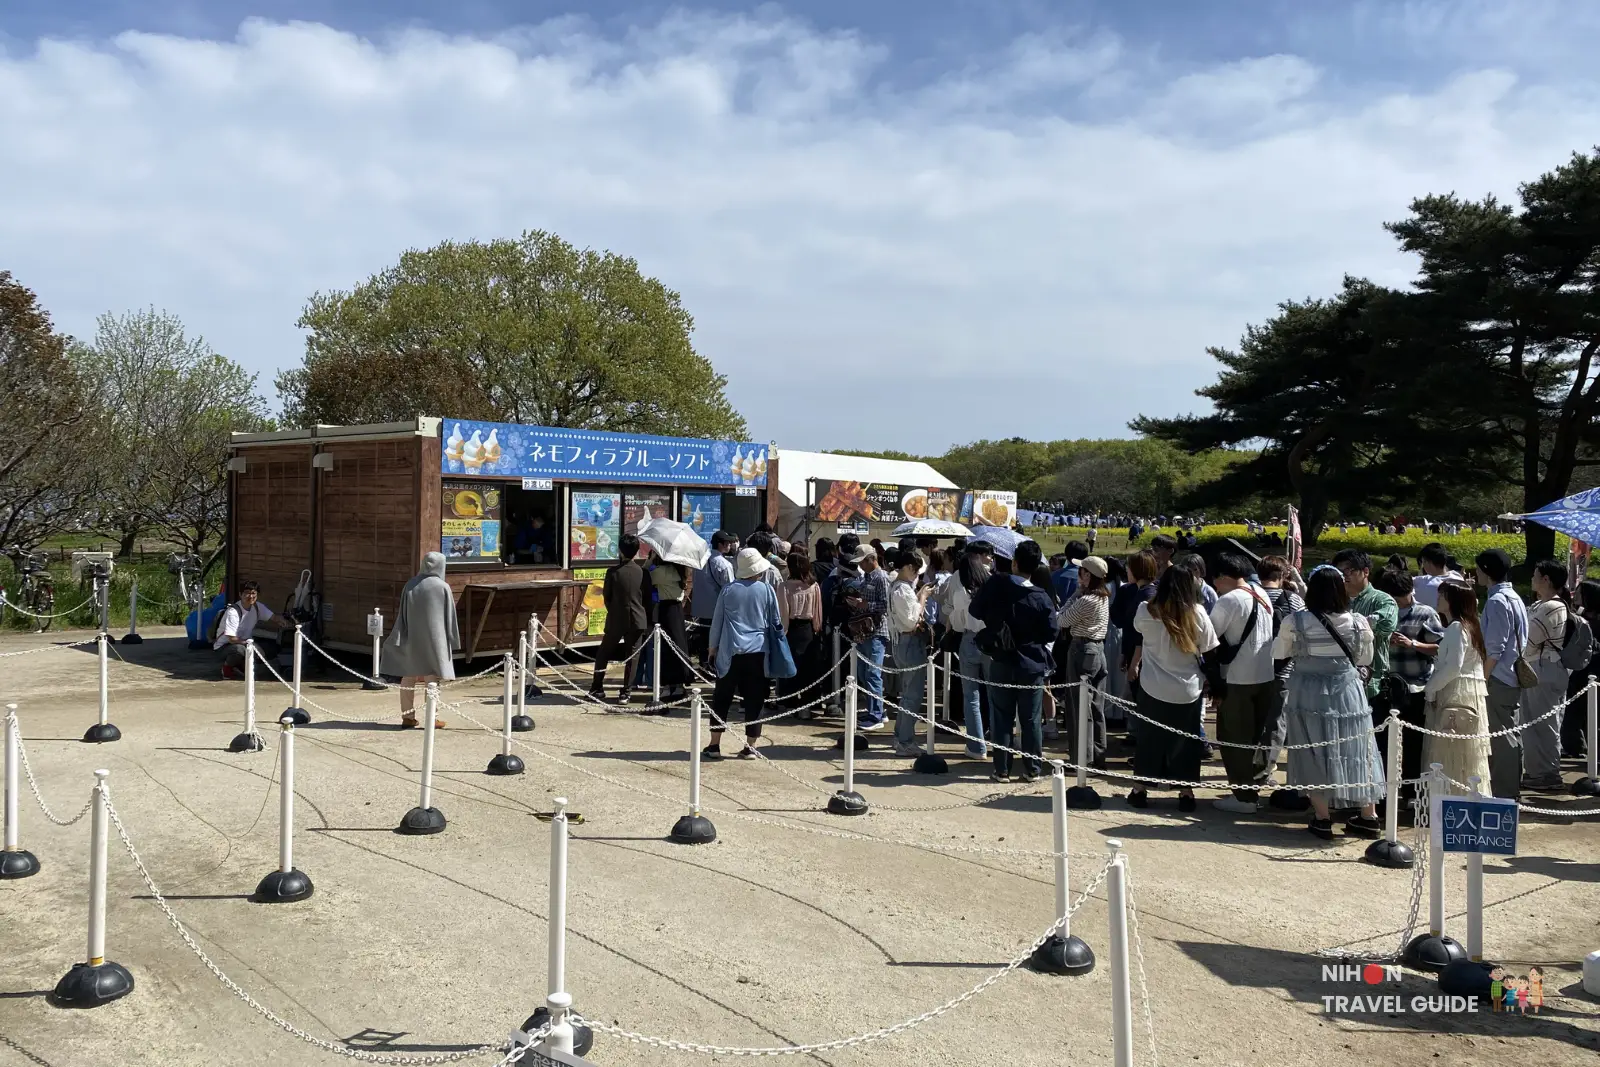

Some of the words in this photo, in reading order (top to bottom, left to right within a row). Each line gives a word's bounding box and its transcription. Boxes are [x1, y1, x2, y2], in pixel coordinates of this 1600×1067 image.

[529, 441, 711, 471] ネモフィラブルーソフト
[1456, 808, 1501, 830] 入口
[1445, 833, 1513, 848] ENTRANCE
